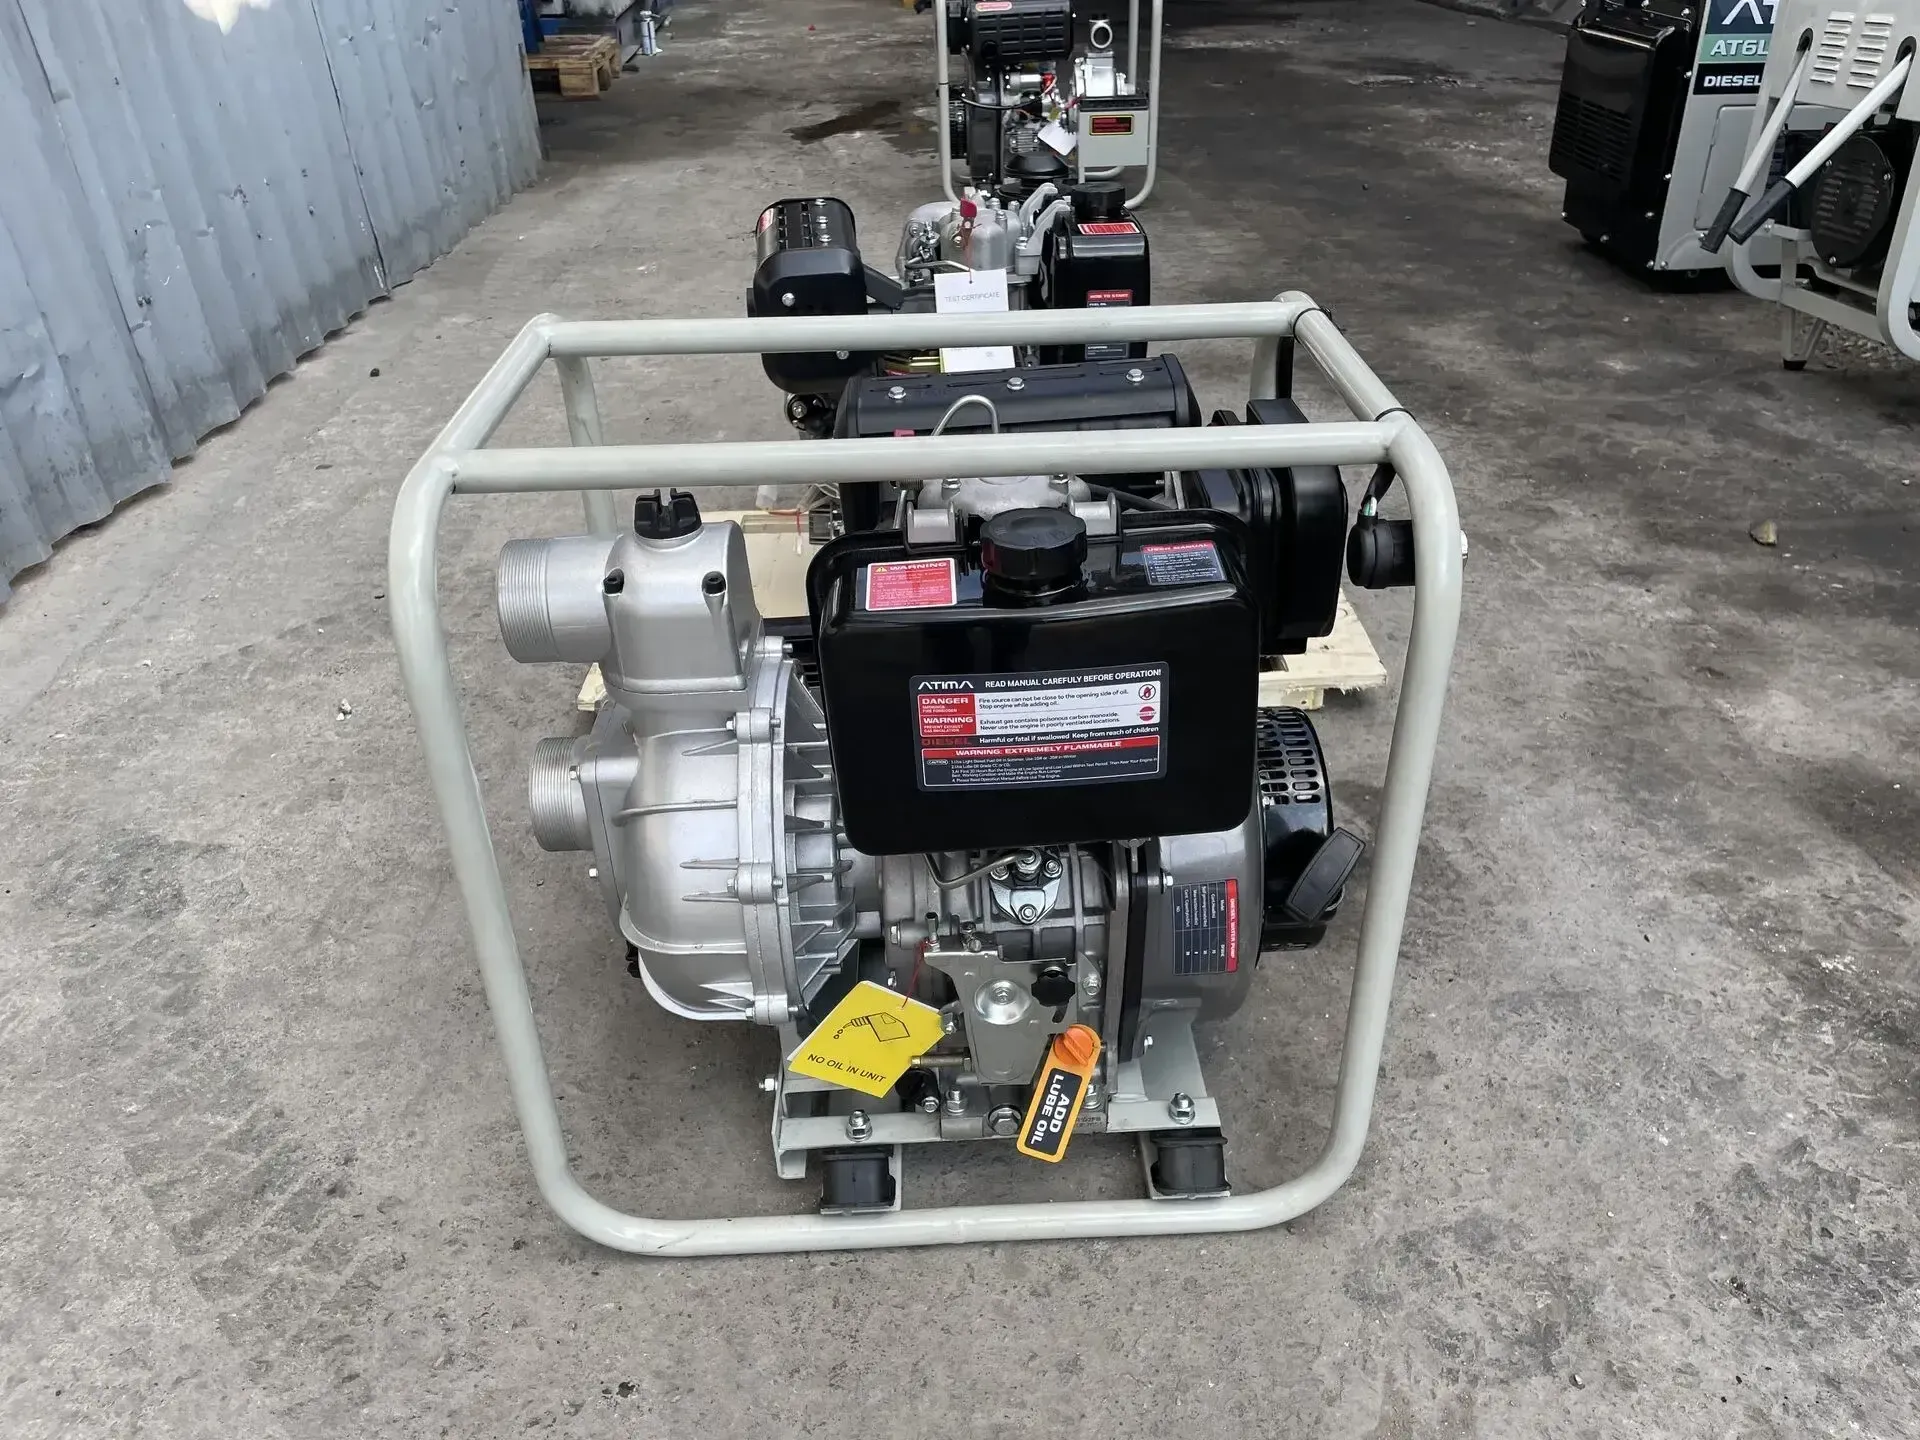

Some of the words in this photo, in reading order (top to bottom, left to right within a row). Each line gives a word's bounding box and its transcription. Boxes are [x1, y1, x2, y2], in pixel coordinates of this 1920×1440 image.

[1703, 75, 1762, 87] DIESEL
[944, 295, 960, 303] TEST
[961, 291, 1000, 301] CERTIFICATE
[889, 562, 947, 571] WARNING
[985, 680, 1006, 688] READ
[1007, 679, 1041, 688] MANUAL
[1042, 676, 1082, 686] CAREFULY
[1083, 673, 1114, 683] BEFORE
[1115, 669, 1162, 680] OPERATION!
[918, 681, 974, 690] ATIMA
[922, 697, 969, 705] DANGER
[1075, 692, 1100, 700] opening
[993, 702, 1013, 710] engine
[923, 716, 974, 724] WARNING
[1039, 715, 1069, 723] poisonous
[1019, 722, 1039, 730] engine
[979, 736, 1006, 744] Harmful
[1014, 735, 1031, 743] fatal
[1036, 733, 1070, 741] swallowed
[1072, 730, 1089, 739] Keep
[1089, 729, 1106, 737] from
[1105, 728, 1125, 736] reach
[1132, 725, 1159, 734] children
[1004, 745, 1062, 755] EXTREMELY
[1063, 741, 1122, 751] FLAMMABLE
[807, 1053, 825, 1064] NO
[826, 1059, 844, 1071] OIL
[845, 1065, 859, 1075] IN
[860, 1069, 887, 1083] UNIT
[1041, 1074, 1065, 1117] LUBE
[1049, 1093, 1070, 1133] ADD
[1030, 1119, 1048, 1145] OIL
